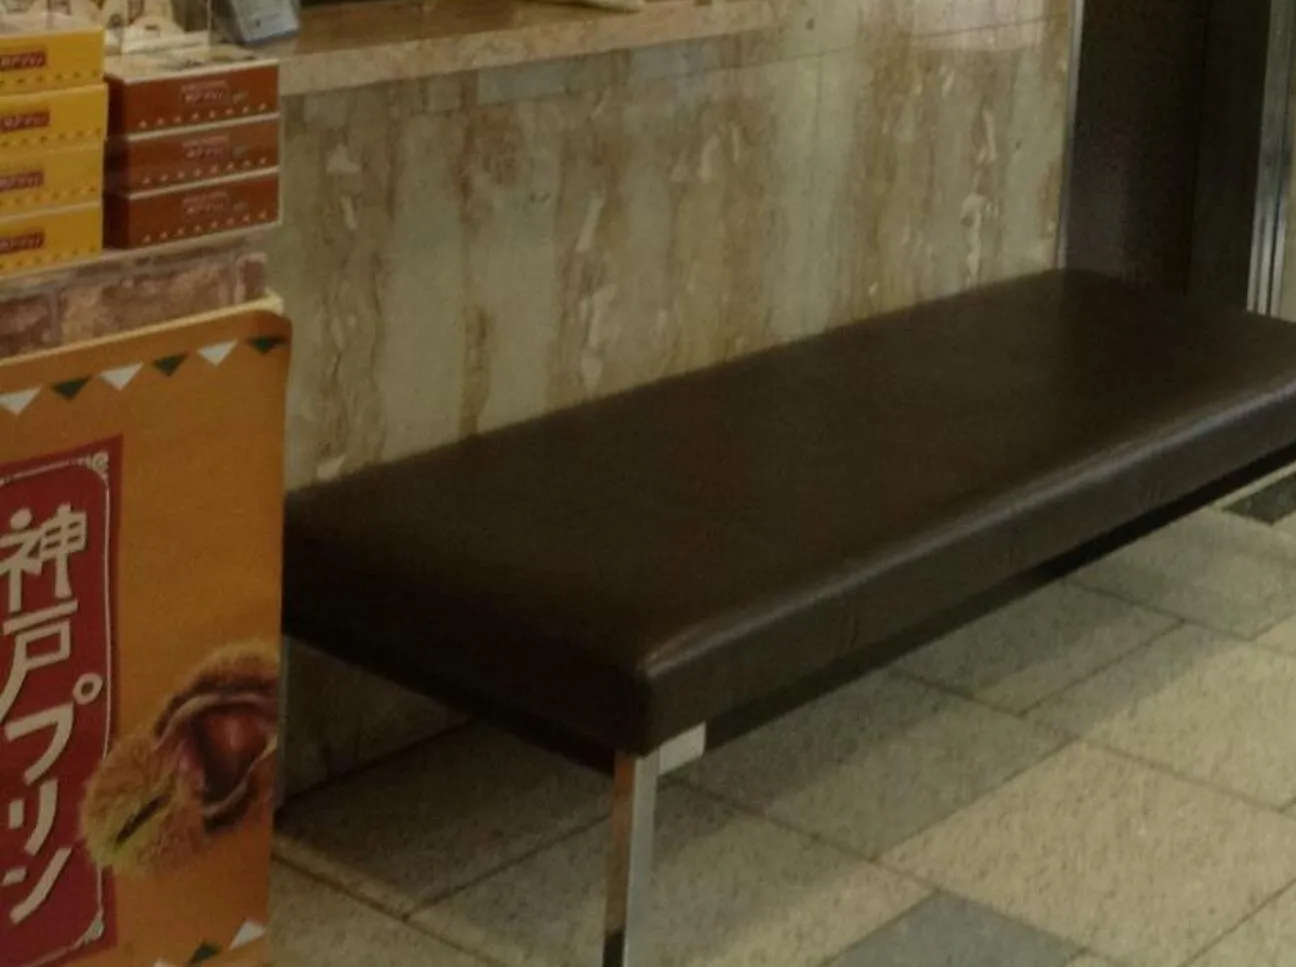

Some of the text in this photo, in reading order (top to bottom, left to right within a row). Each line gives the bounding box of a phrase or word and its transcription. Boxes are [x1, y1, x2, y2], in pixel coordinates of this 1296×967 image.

[0, 503, 103, 925] 神戸プリン
